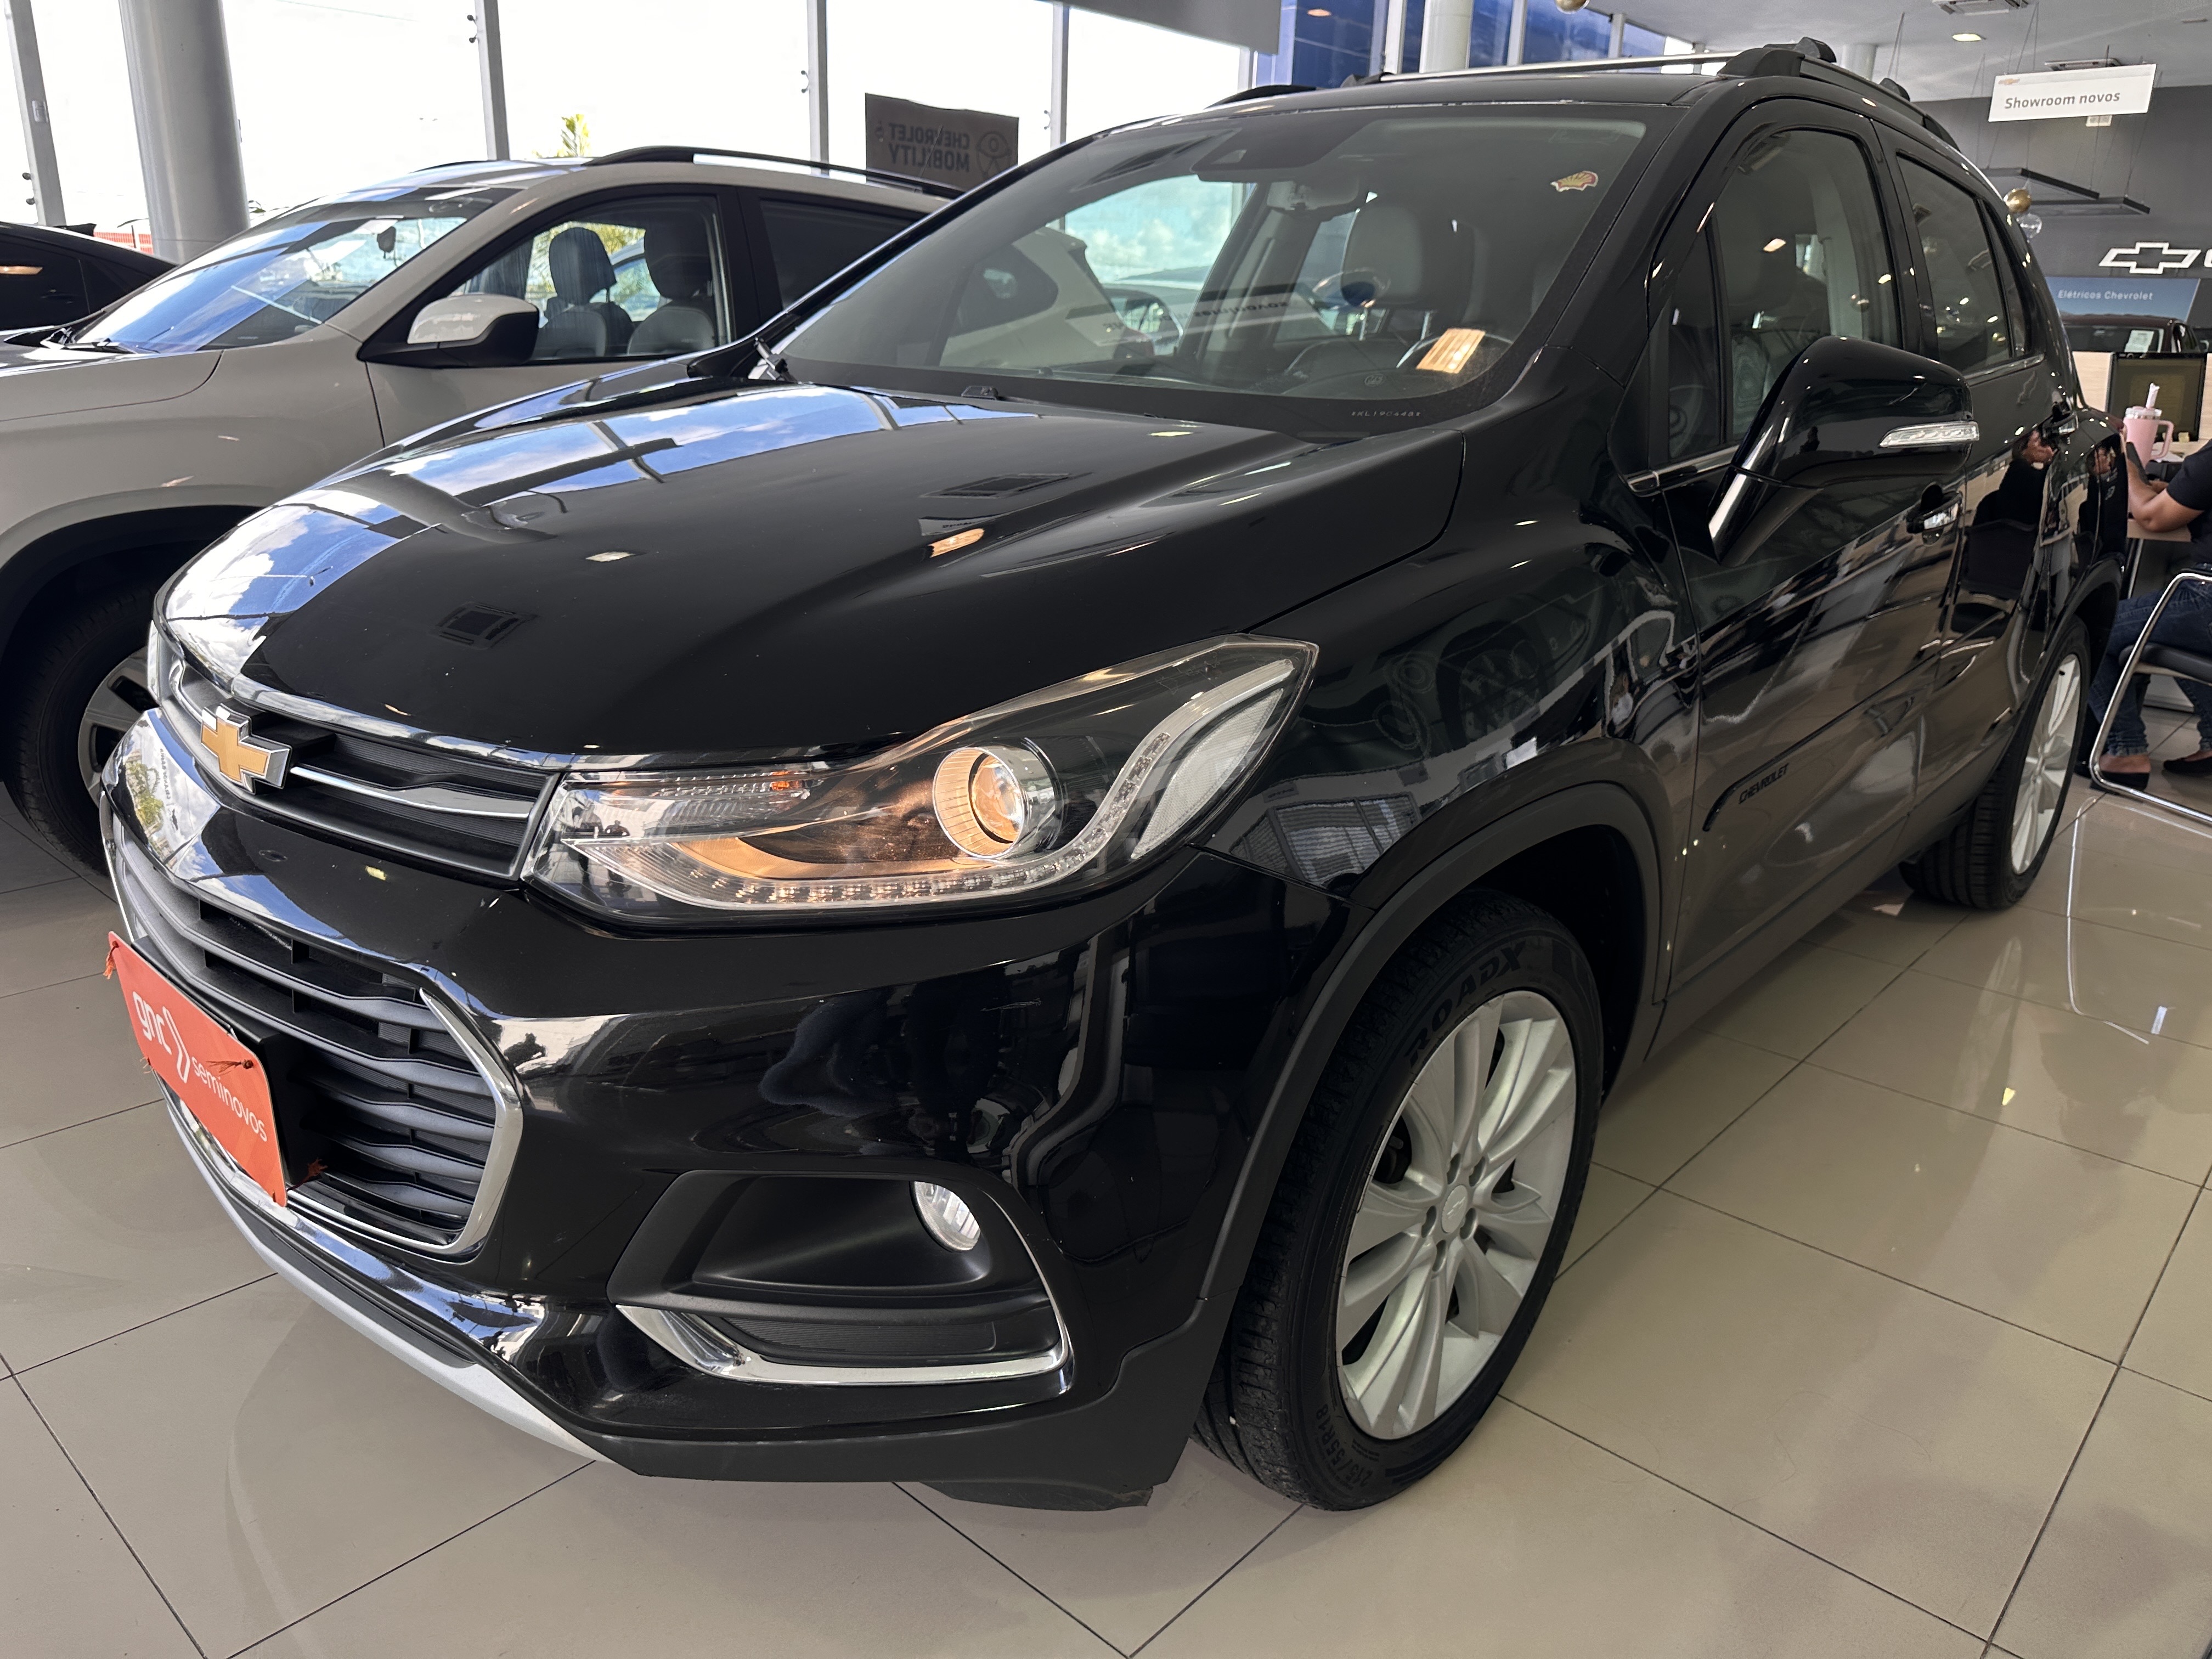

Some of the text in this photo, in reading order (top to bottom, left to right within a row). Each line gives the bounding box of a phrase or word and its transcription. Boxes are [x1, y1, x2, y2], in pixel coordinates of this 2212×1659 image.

[2004, 92, 2120, 109] Showroom novos
[2058, 289, 2153, 301] Elétricos Chevrolet
[1739, 763, 1789, 804] CHEVROLET
[1404, 940, 1526, 1068] ROADX
[191, 1056, 268, 1142] seminovos
